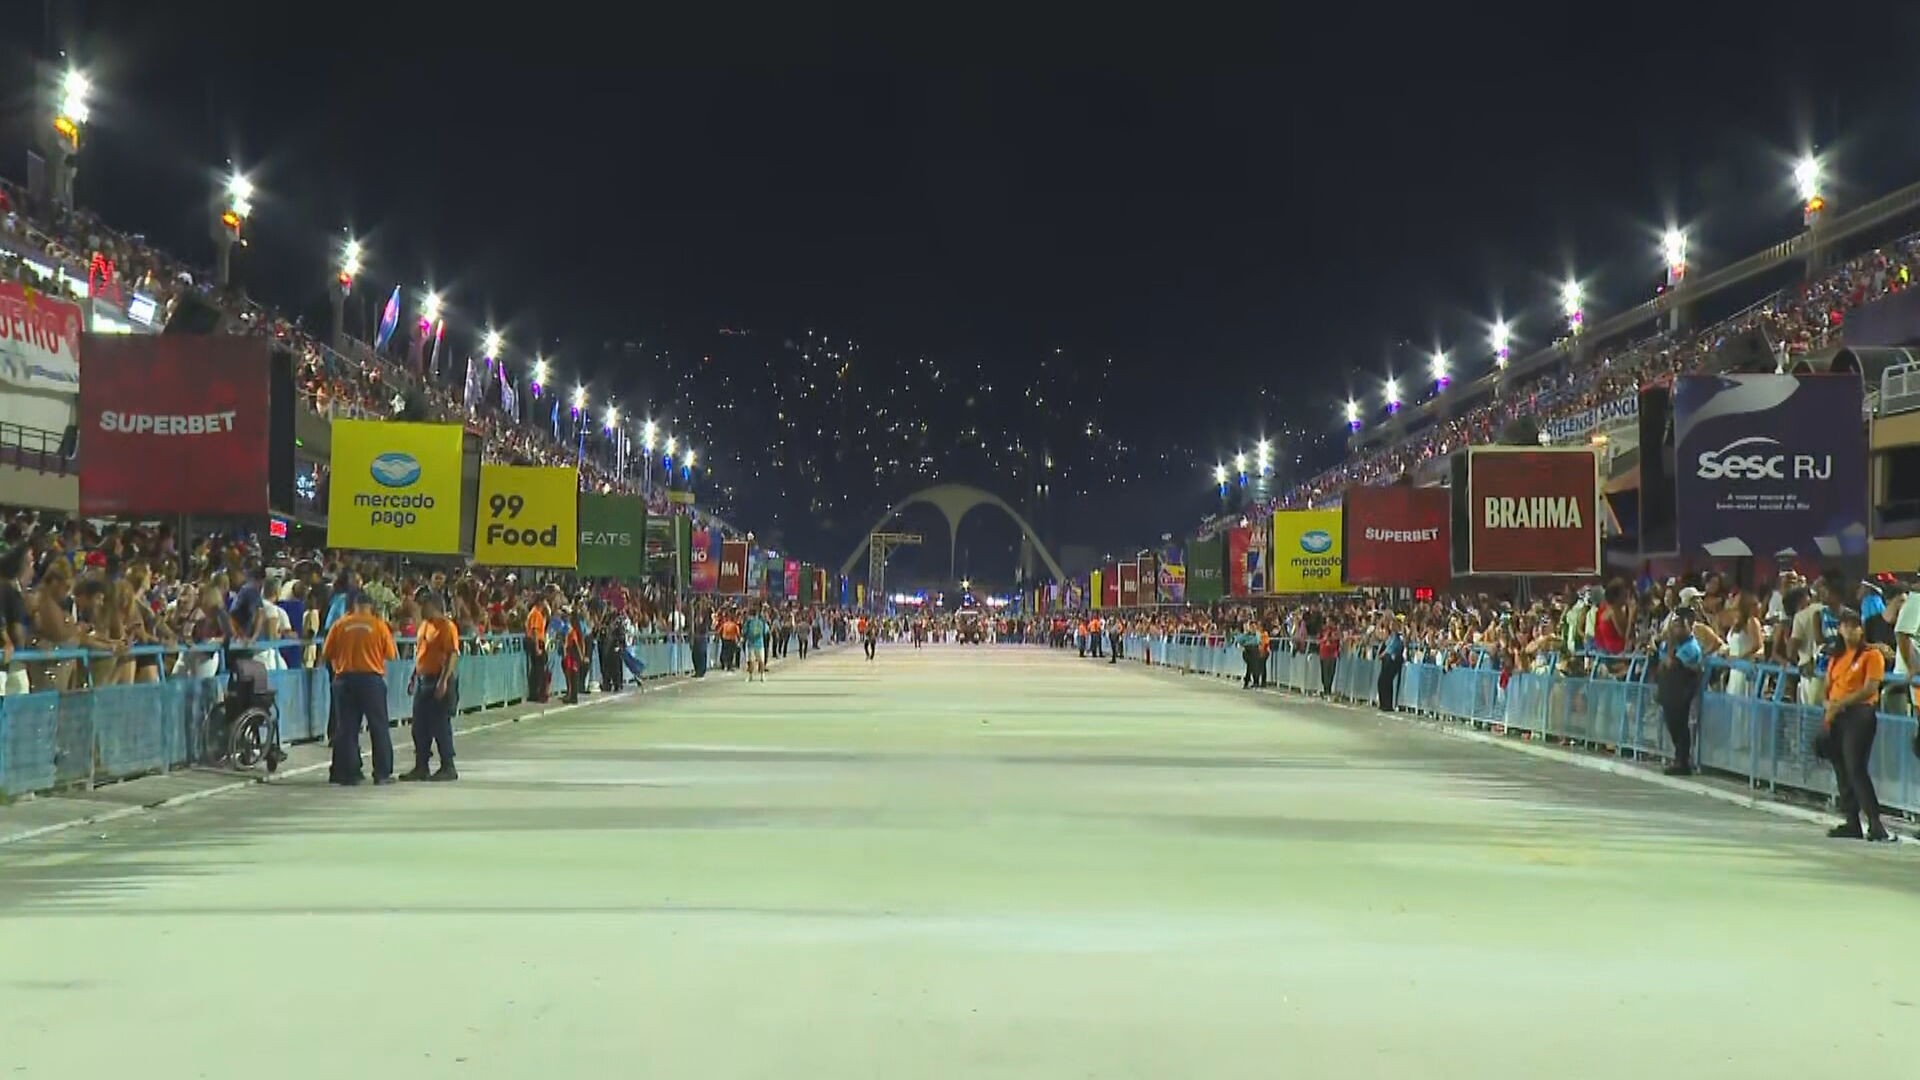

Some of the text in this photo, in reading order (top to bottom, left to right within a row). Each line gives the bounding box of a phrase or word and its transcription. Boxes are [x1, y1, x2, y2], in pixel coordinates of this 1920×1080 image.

[100, 410, 236, 434] SUPERBET
[1697, 445, 1832, 479] Sesc RJ
[354, 493, 435, 509] mercado
[489, 494, 524, 519] 99
[371, 511, 416, 528] pago
[1484, 497, 1582, 529] BRAHMA
[487, 524, 557, 547] Food
[581, 531, 631, 546] EATS
[1365, 528, 1439, 543] SUPERBET
[1302, 567, 1331, 579] pago
